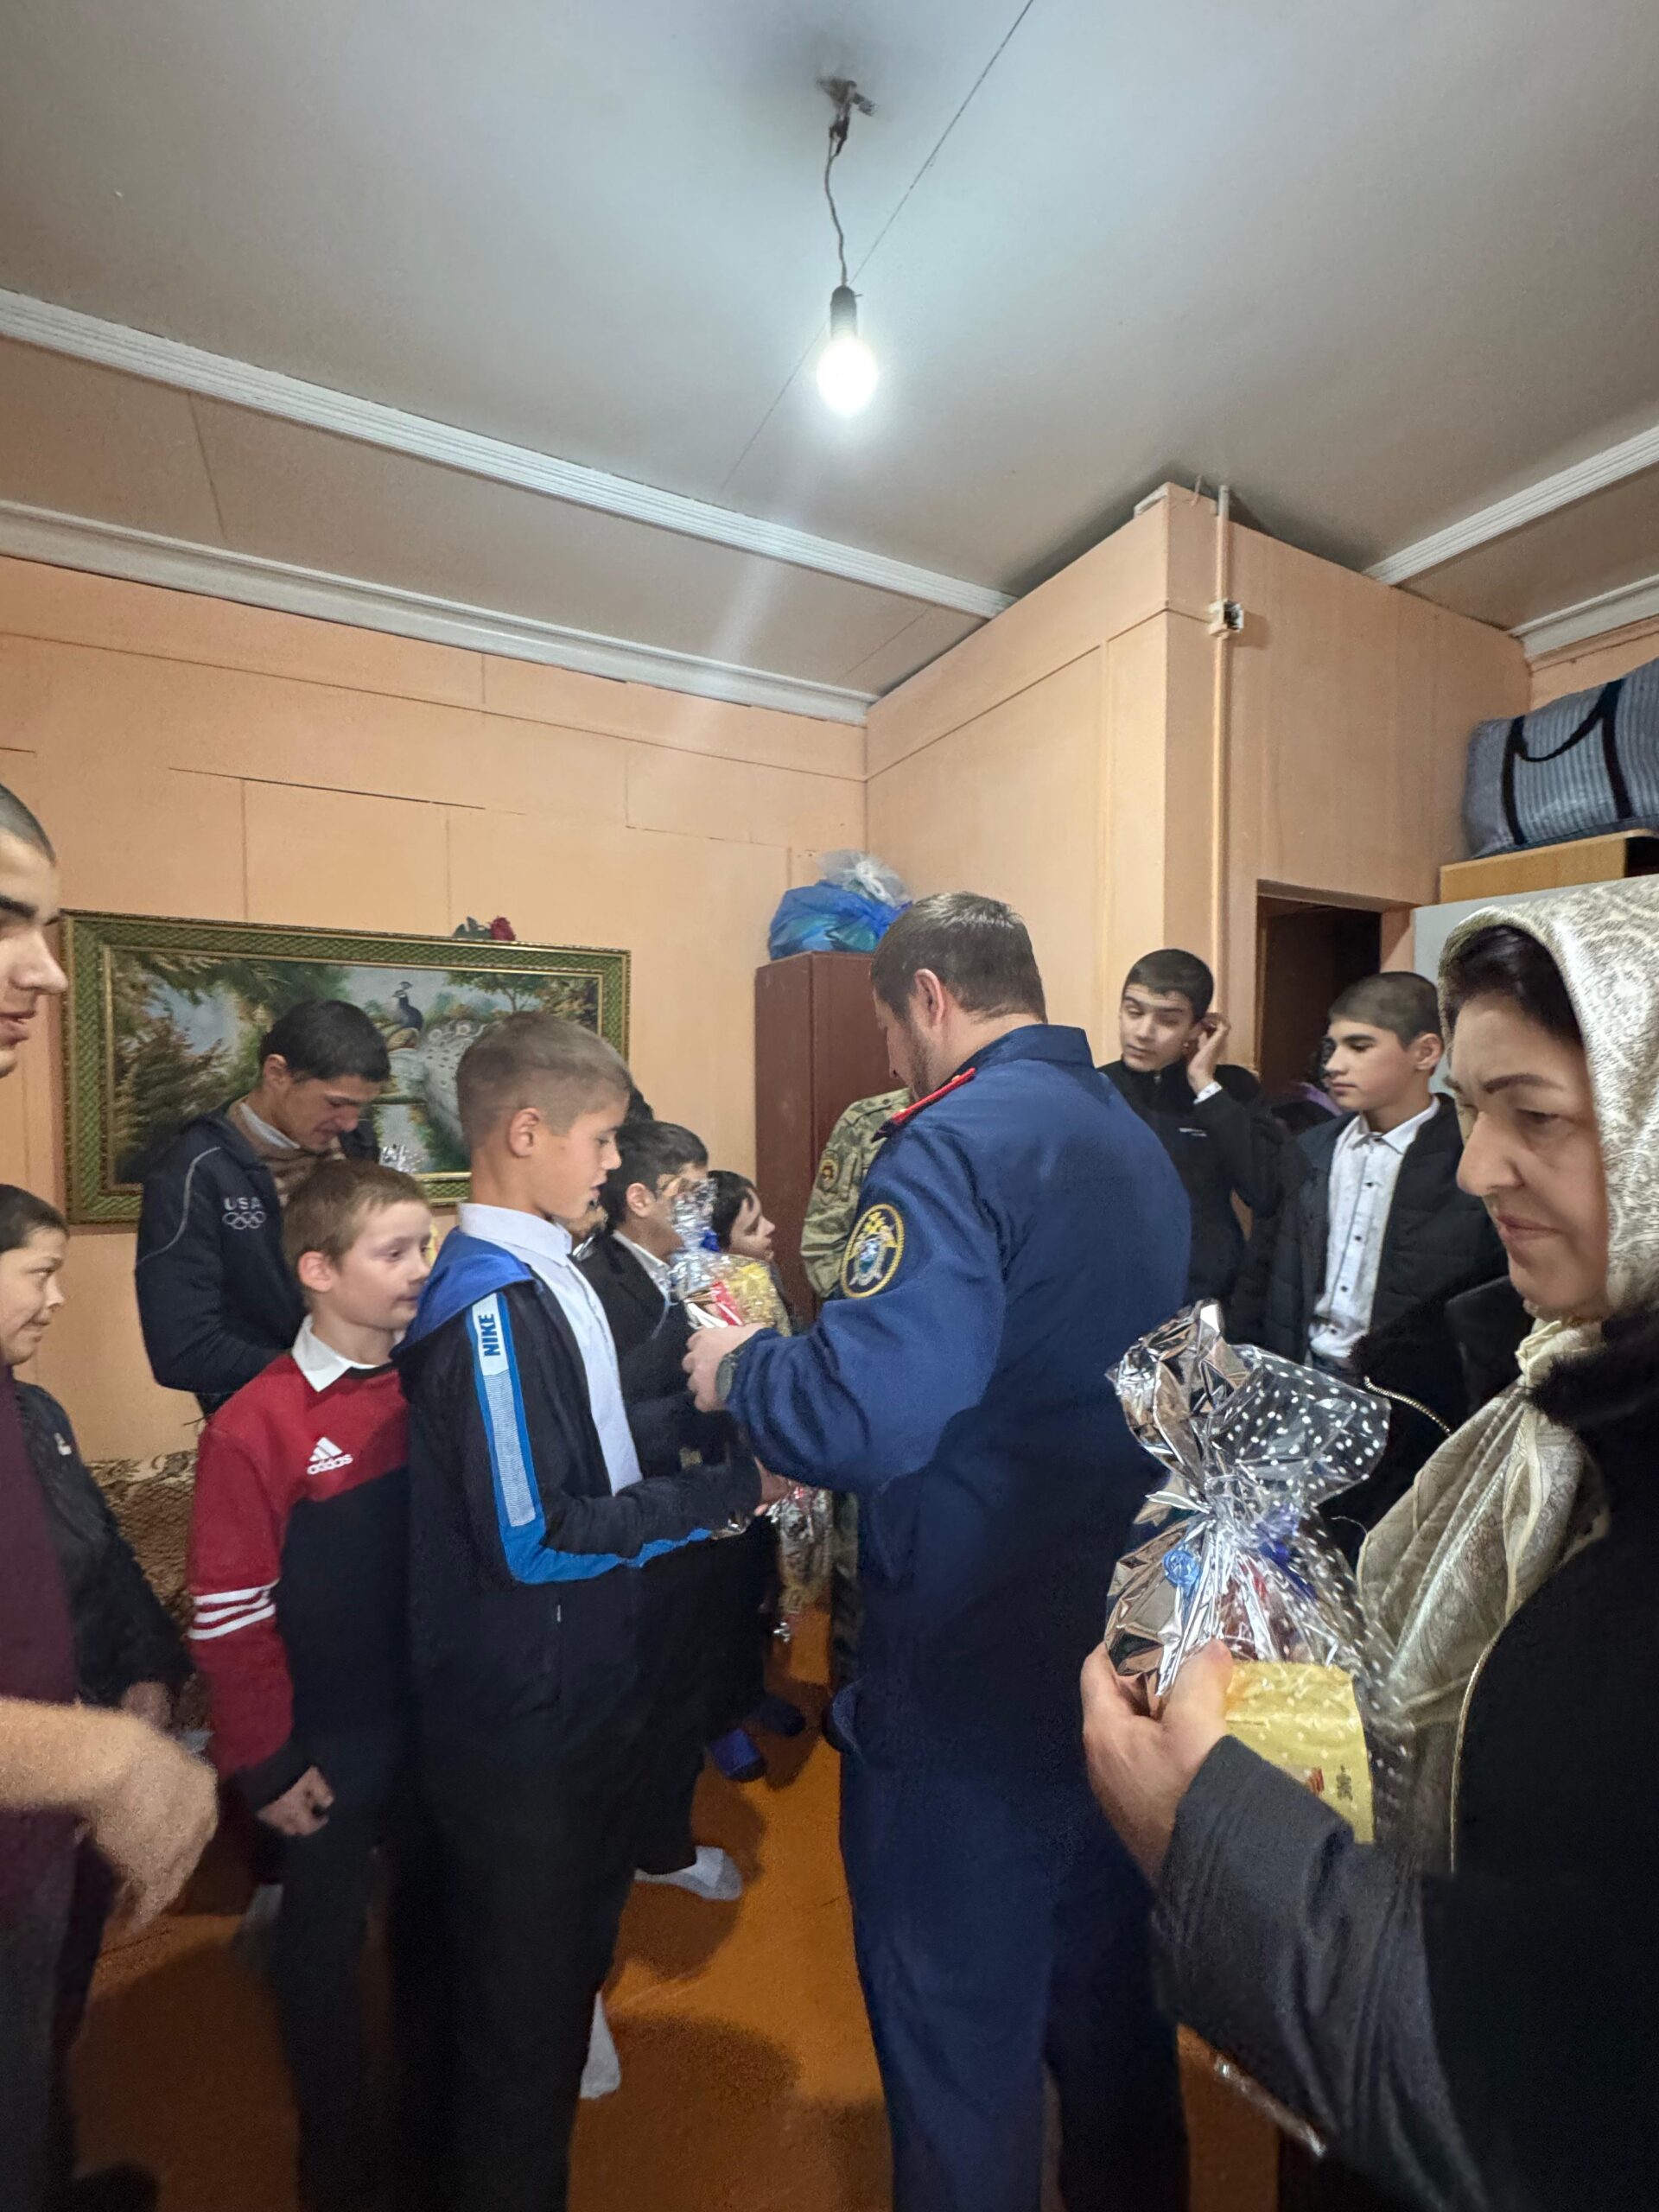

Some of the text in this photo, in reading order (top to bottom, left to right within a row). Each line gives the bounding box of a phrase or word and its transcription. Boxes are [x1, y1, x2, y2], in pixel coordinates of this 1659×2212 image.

[224, 1197, 263, 1211] USA
[478, 1313, 501, 1357] NIKE
[307, 1454, 353, 1475] adidas
